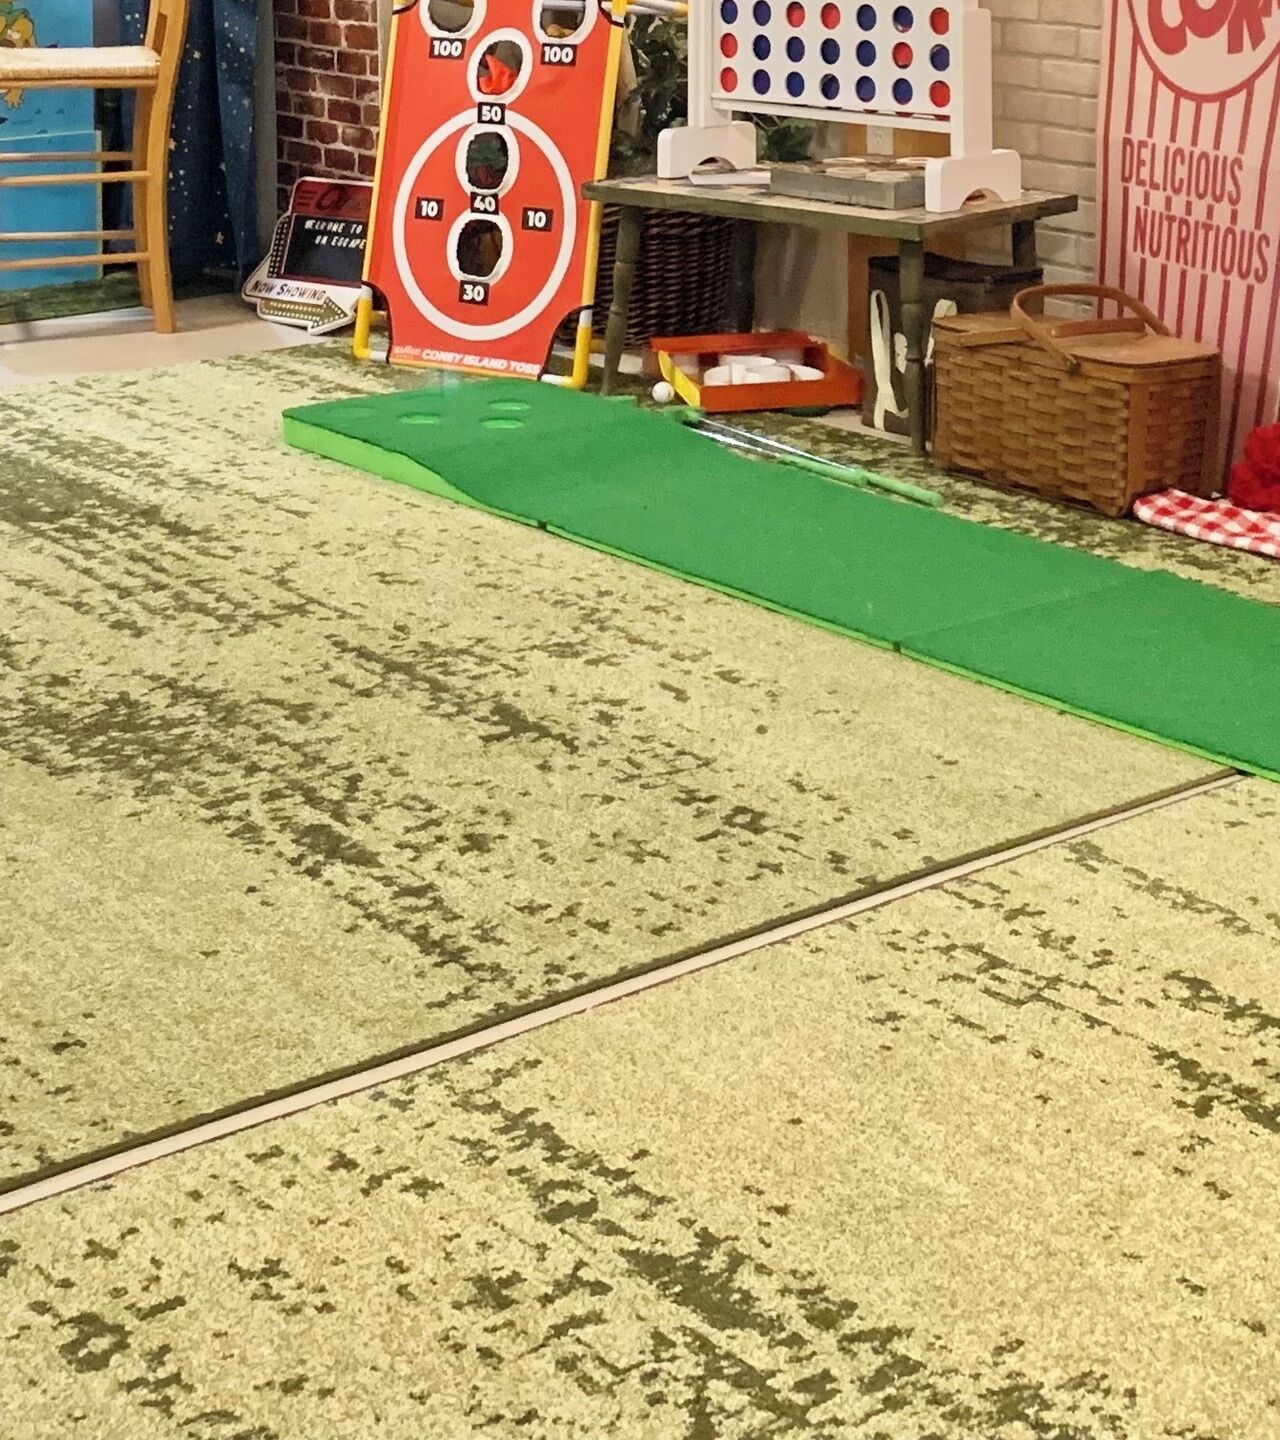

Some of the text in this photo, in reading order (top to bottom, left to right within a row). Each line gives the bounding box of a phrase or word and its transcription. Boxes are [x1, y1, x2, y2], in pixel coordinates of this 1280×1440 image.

[432, 40, 463, 57] 100
[543, 46, 574, 63] 100
[481, 105, 502, 122] 50
[1120, 136, 1244, 208] DELICIOUS
[420, 200, 438, 218] 10
[473, 196, 496, 212] 40
[527, 210, 546, 228] 10
[350, 224, 363, 235] TO
[1133, 204, 1271, 285] NUTRITIOUS
[463, 285, 485, 302] 30
[421, 349, 463, 363] CONEY
[462, 354, 508, 370] ISLAND
[508, 360, 542, 375] TOSS
